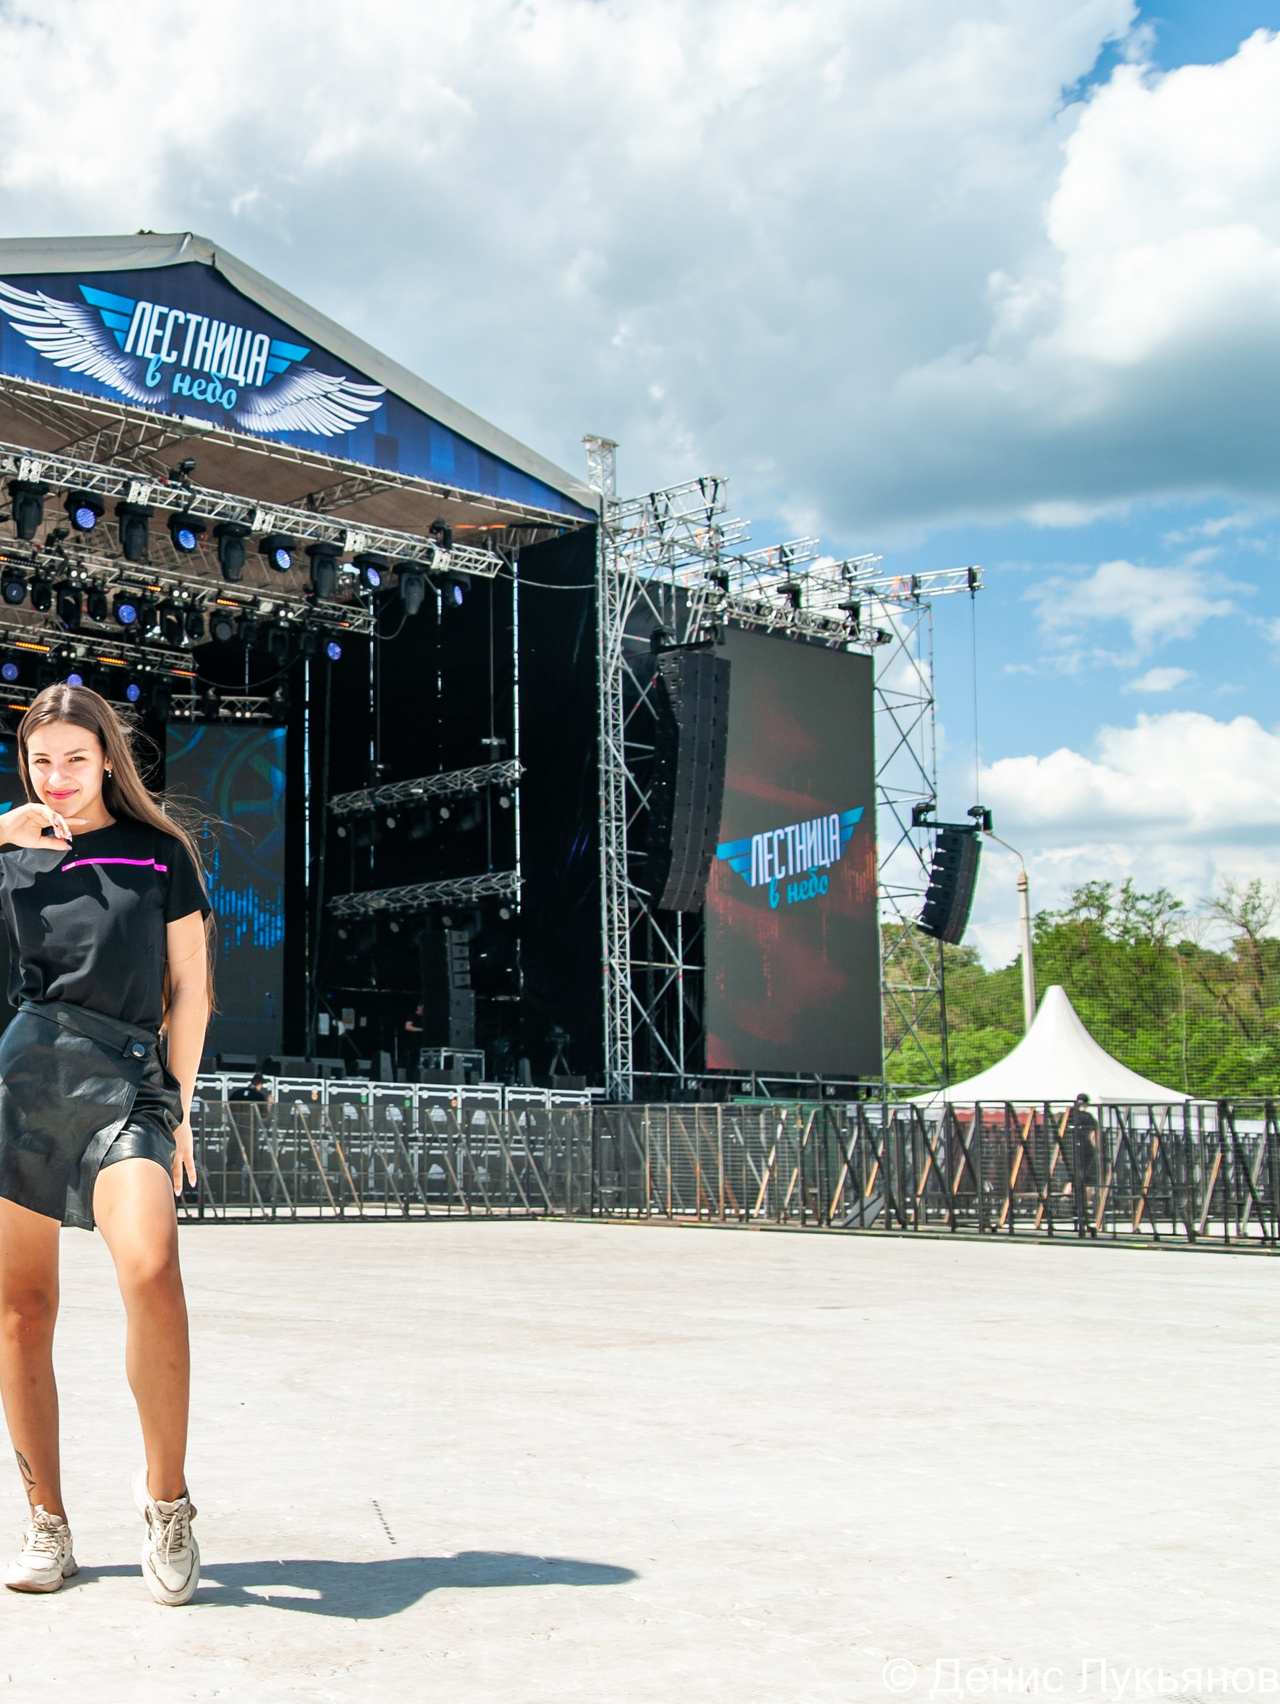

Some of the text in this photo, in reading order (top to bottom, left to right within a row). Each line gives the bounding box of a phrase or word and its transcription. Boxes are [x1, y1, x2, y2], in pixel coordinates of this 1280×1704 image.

[124, 300, 270, 387] ЛЕСТНИЦА
[145, 353, 237, 410] в небо
[751, 813, 841, 888] ЛЕСТНИЦА
[769, 866, 829, 909] в небо
